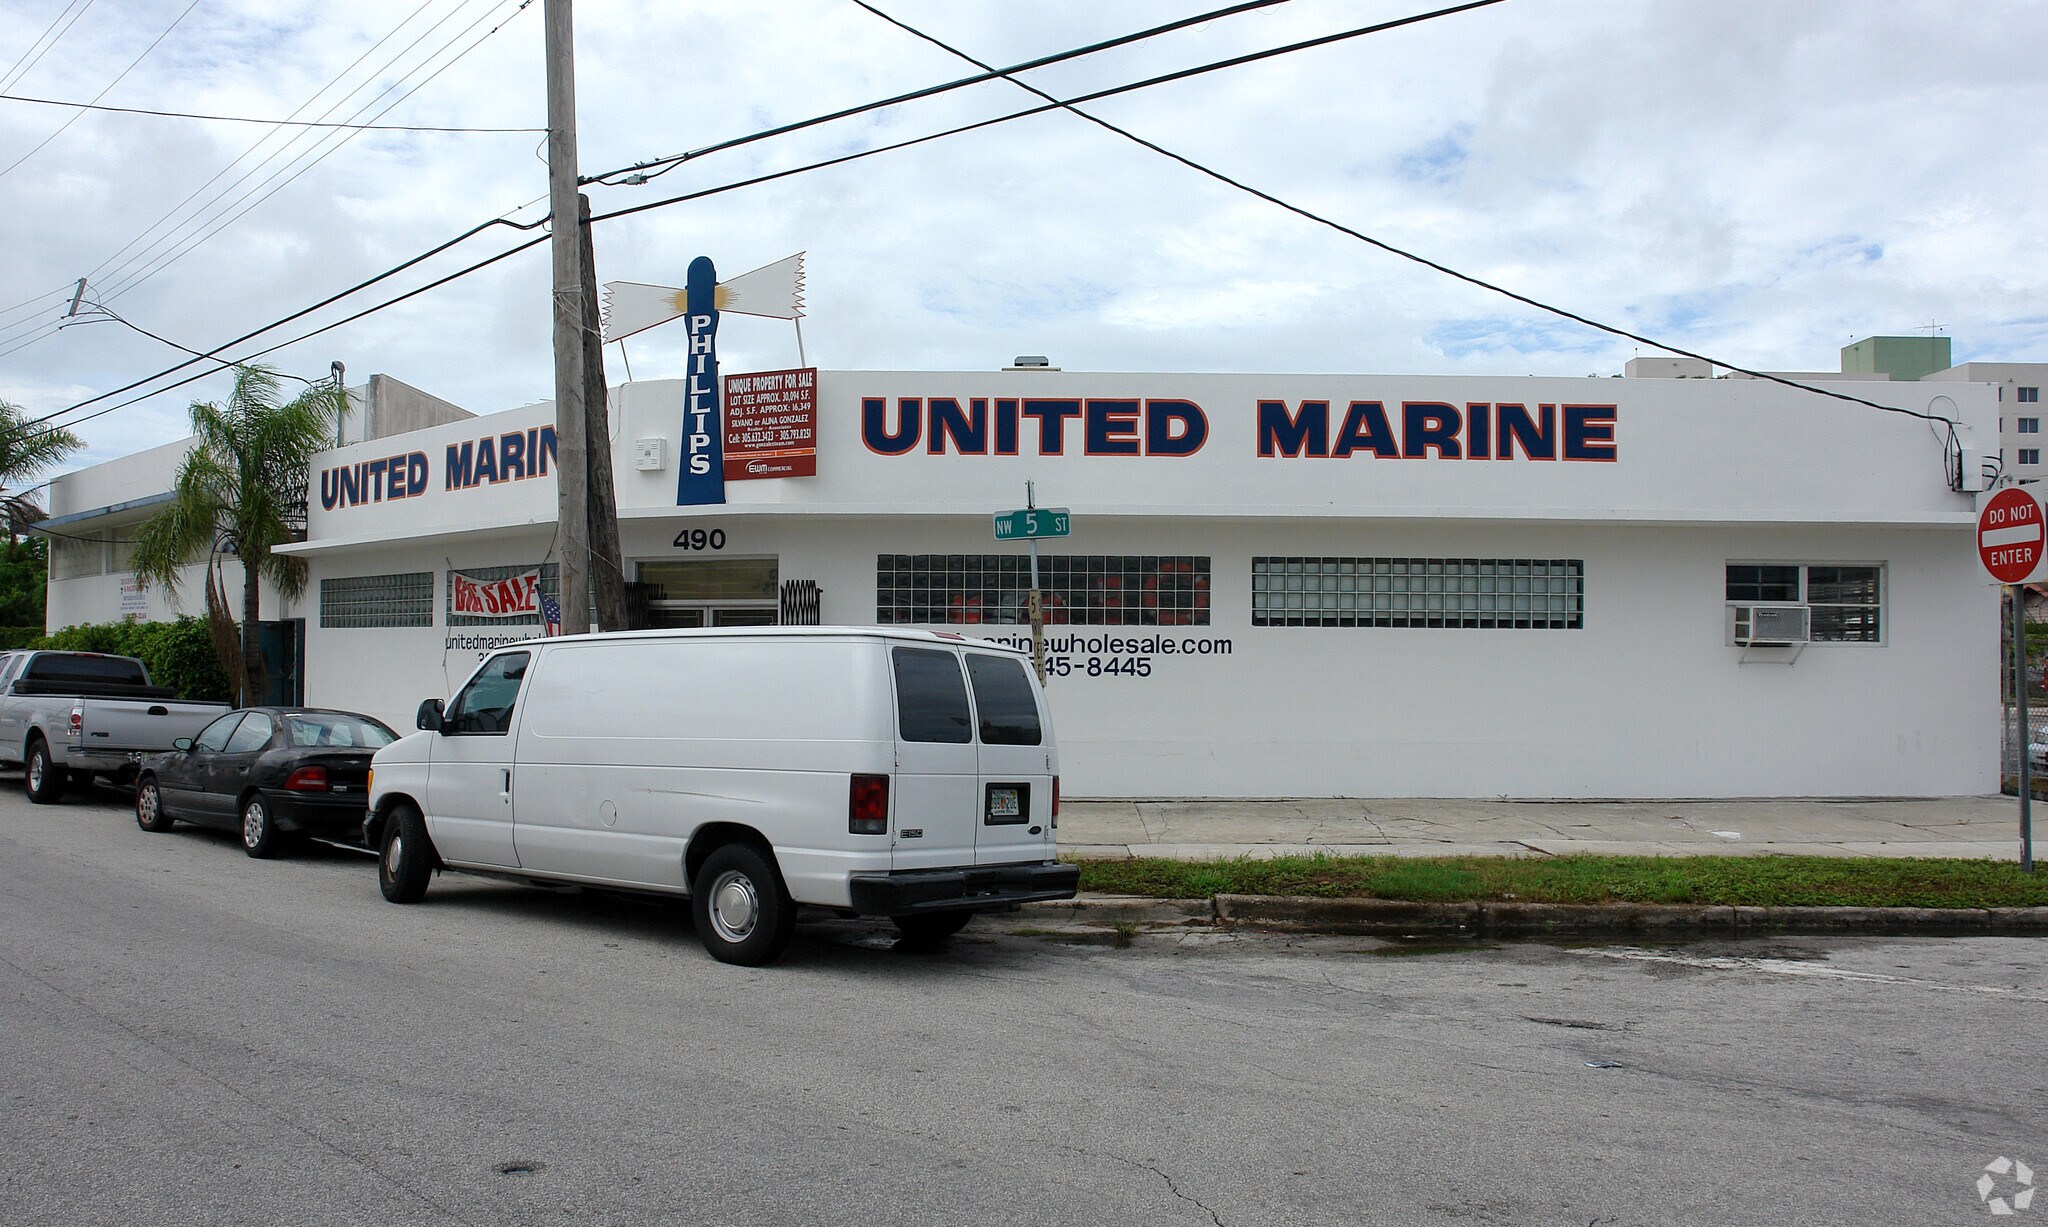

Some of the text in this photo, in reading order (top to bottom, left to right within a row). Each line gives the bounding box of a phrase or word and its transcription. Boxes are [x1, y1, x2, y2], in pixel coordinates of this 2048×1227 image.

[728, 372, 812, 394] UNIQUE PROPERTY FOR SALE
[689, 315, 711, 475] PHILLIPS
[730, 396, 742, 406] LOT
[743, 395, 754, 405] SIZE
[757, 392, 781, 404] APPROX.
[801, 390, 810, 400] S.F.
[760, 404, 790, 413] APPROX:
[792, 402, 811, 412] 16,349
[732, 419, 753, 427] SILVANO
[761, 417, 778, 425] ALINA
[779, 414, 808, 424] GONZALEZ
[861, 397, 1618, 463] UNITED MARINE
[728, 434, 740, 443] Cell:
[321, 423, 558, 511] UNITED MARIN
[996, 513, 1066, 535] NW 5 ST
[1989, 504, 2033, 524] DO NOT
[673, 528, 726, 550] 490
[1991, 548, 2032, 566] ENTER
[455, 576, 538, 614] BIG SALE
[901, 830, 923, 838] E150
